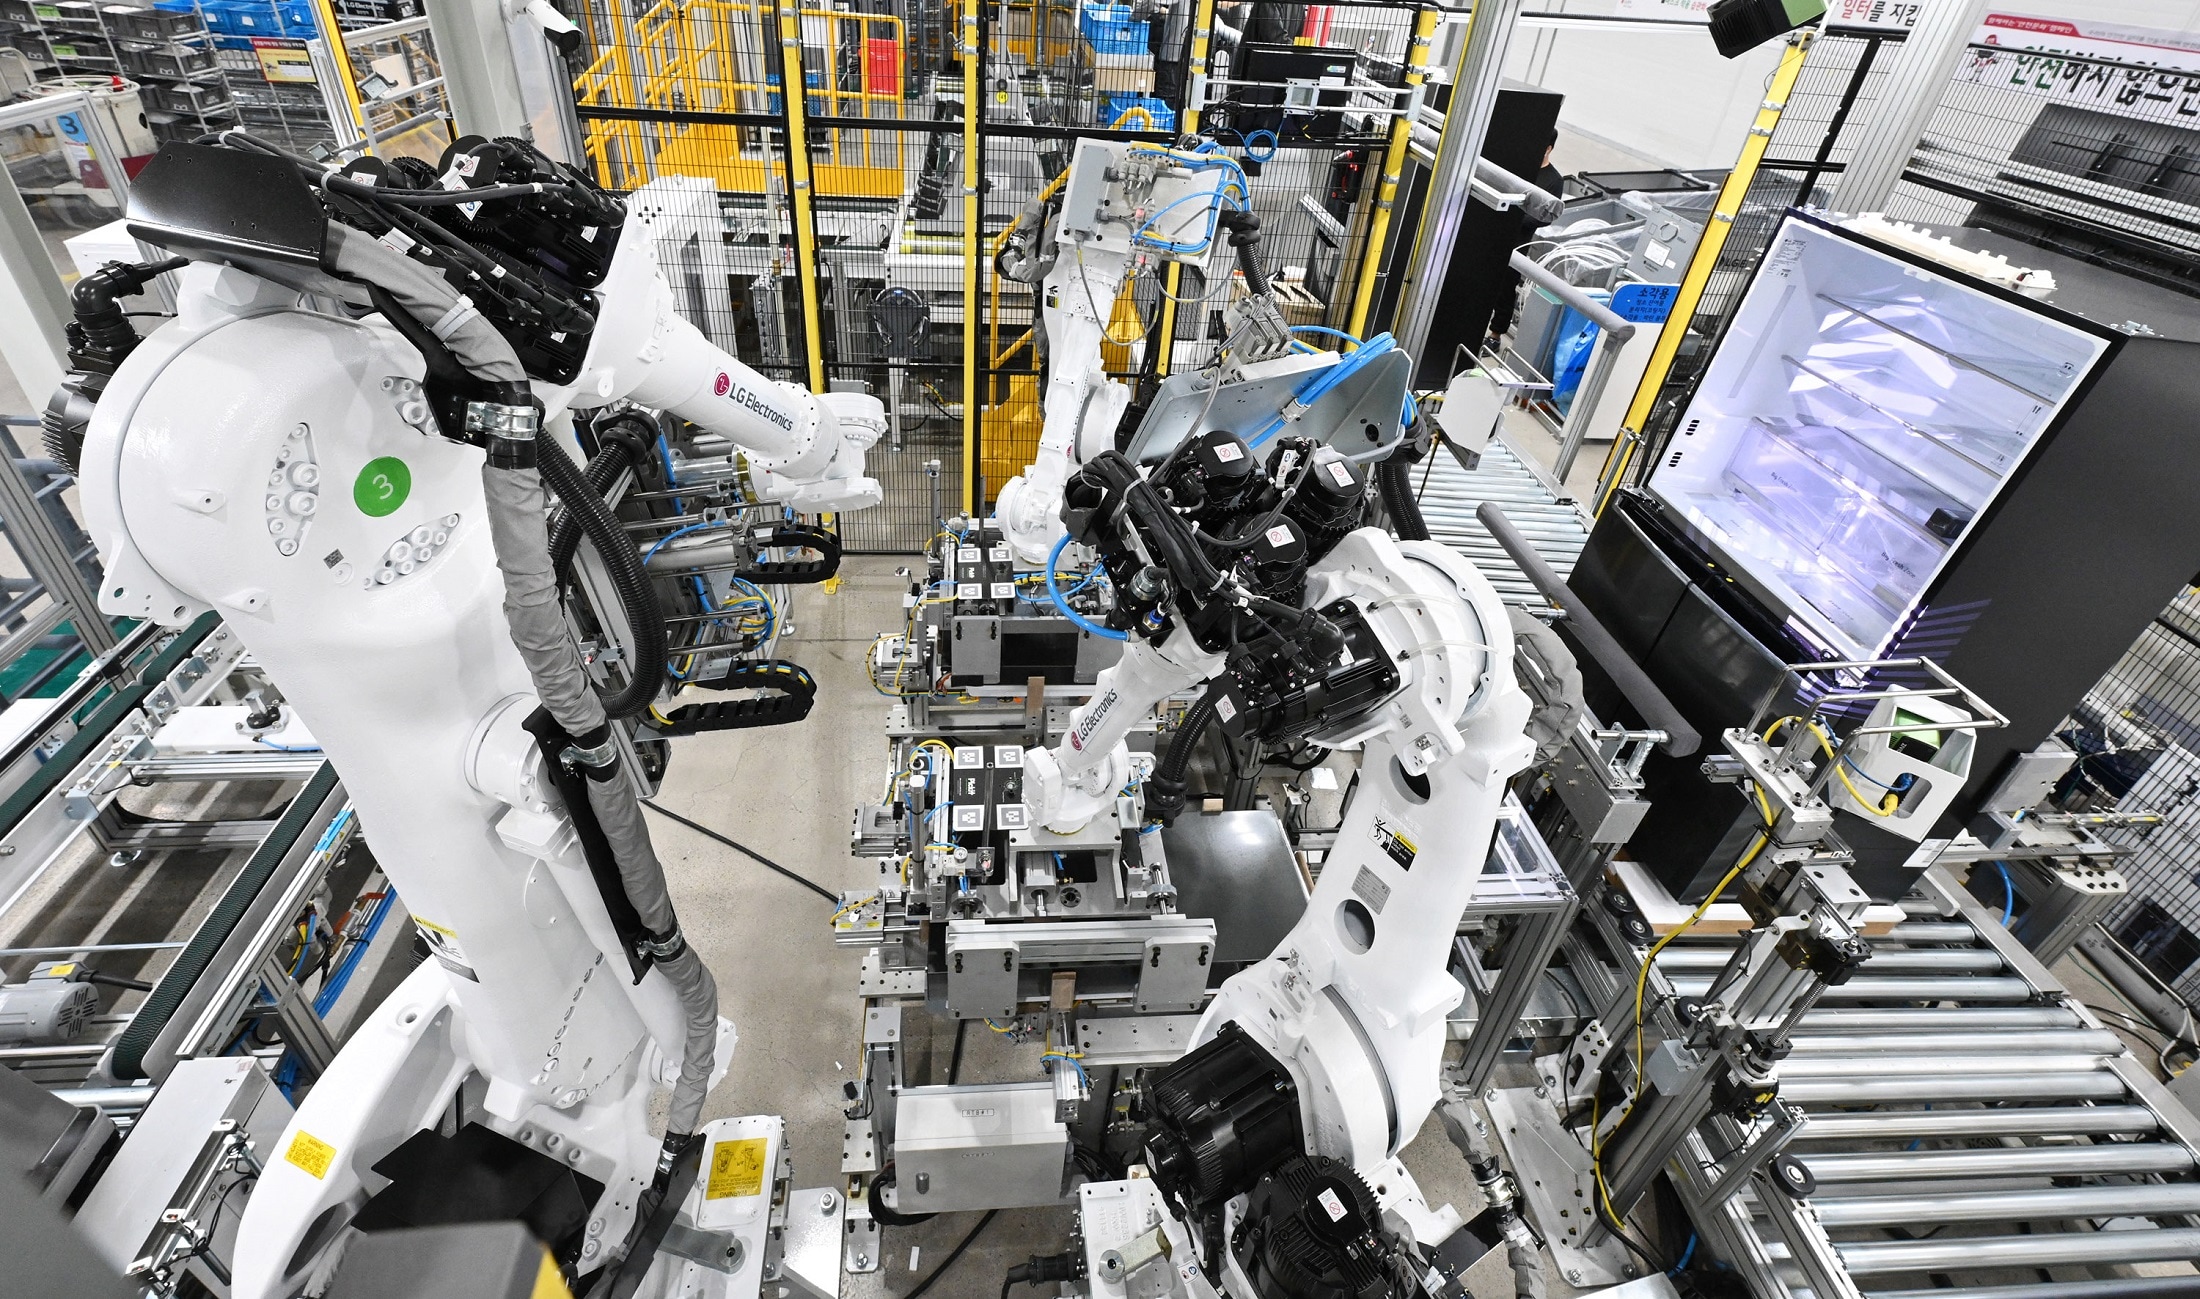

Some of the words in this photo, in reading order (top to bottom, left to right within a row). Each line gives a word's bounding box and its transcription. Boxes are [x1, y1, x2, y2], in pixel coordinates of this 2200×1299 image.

[1841, 0, 1886, 22] 일터를
[58, 115, 79, 134] 3
[1637, 287, 1669, 300] 소각용
[728, 382, 747, 404] LG
[744, 391, 794, 431] Electronics
[372, 473, 394, 500] 3
[1076, 722, 1089, 741] LG
[1084, 688, 1118, 732] Electronics
